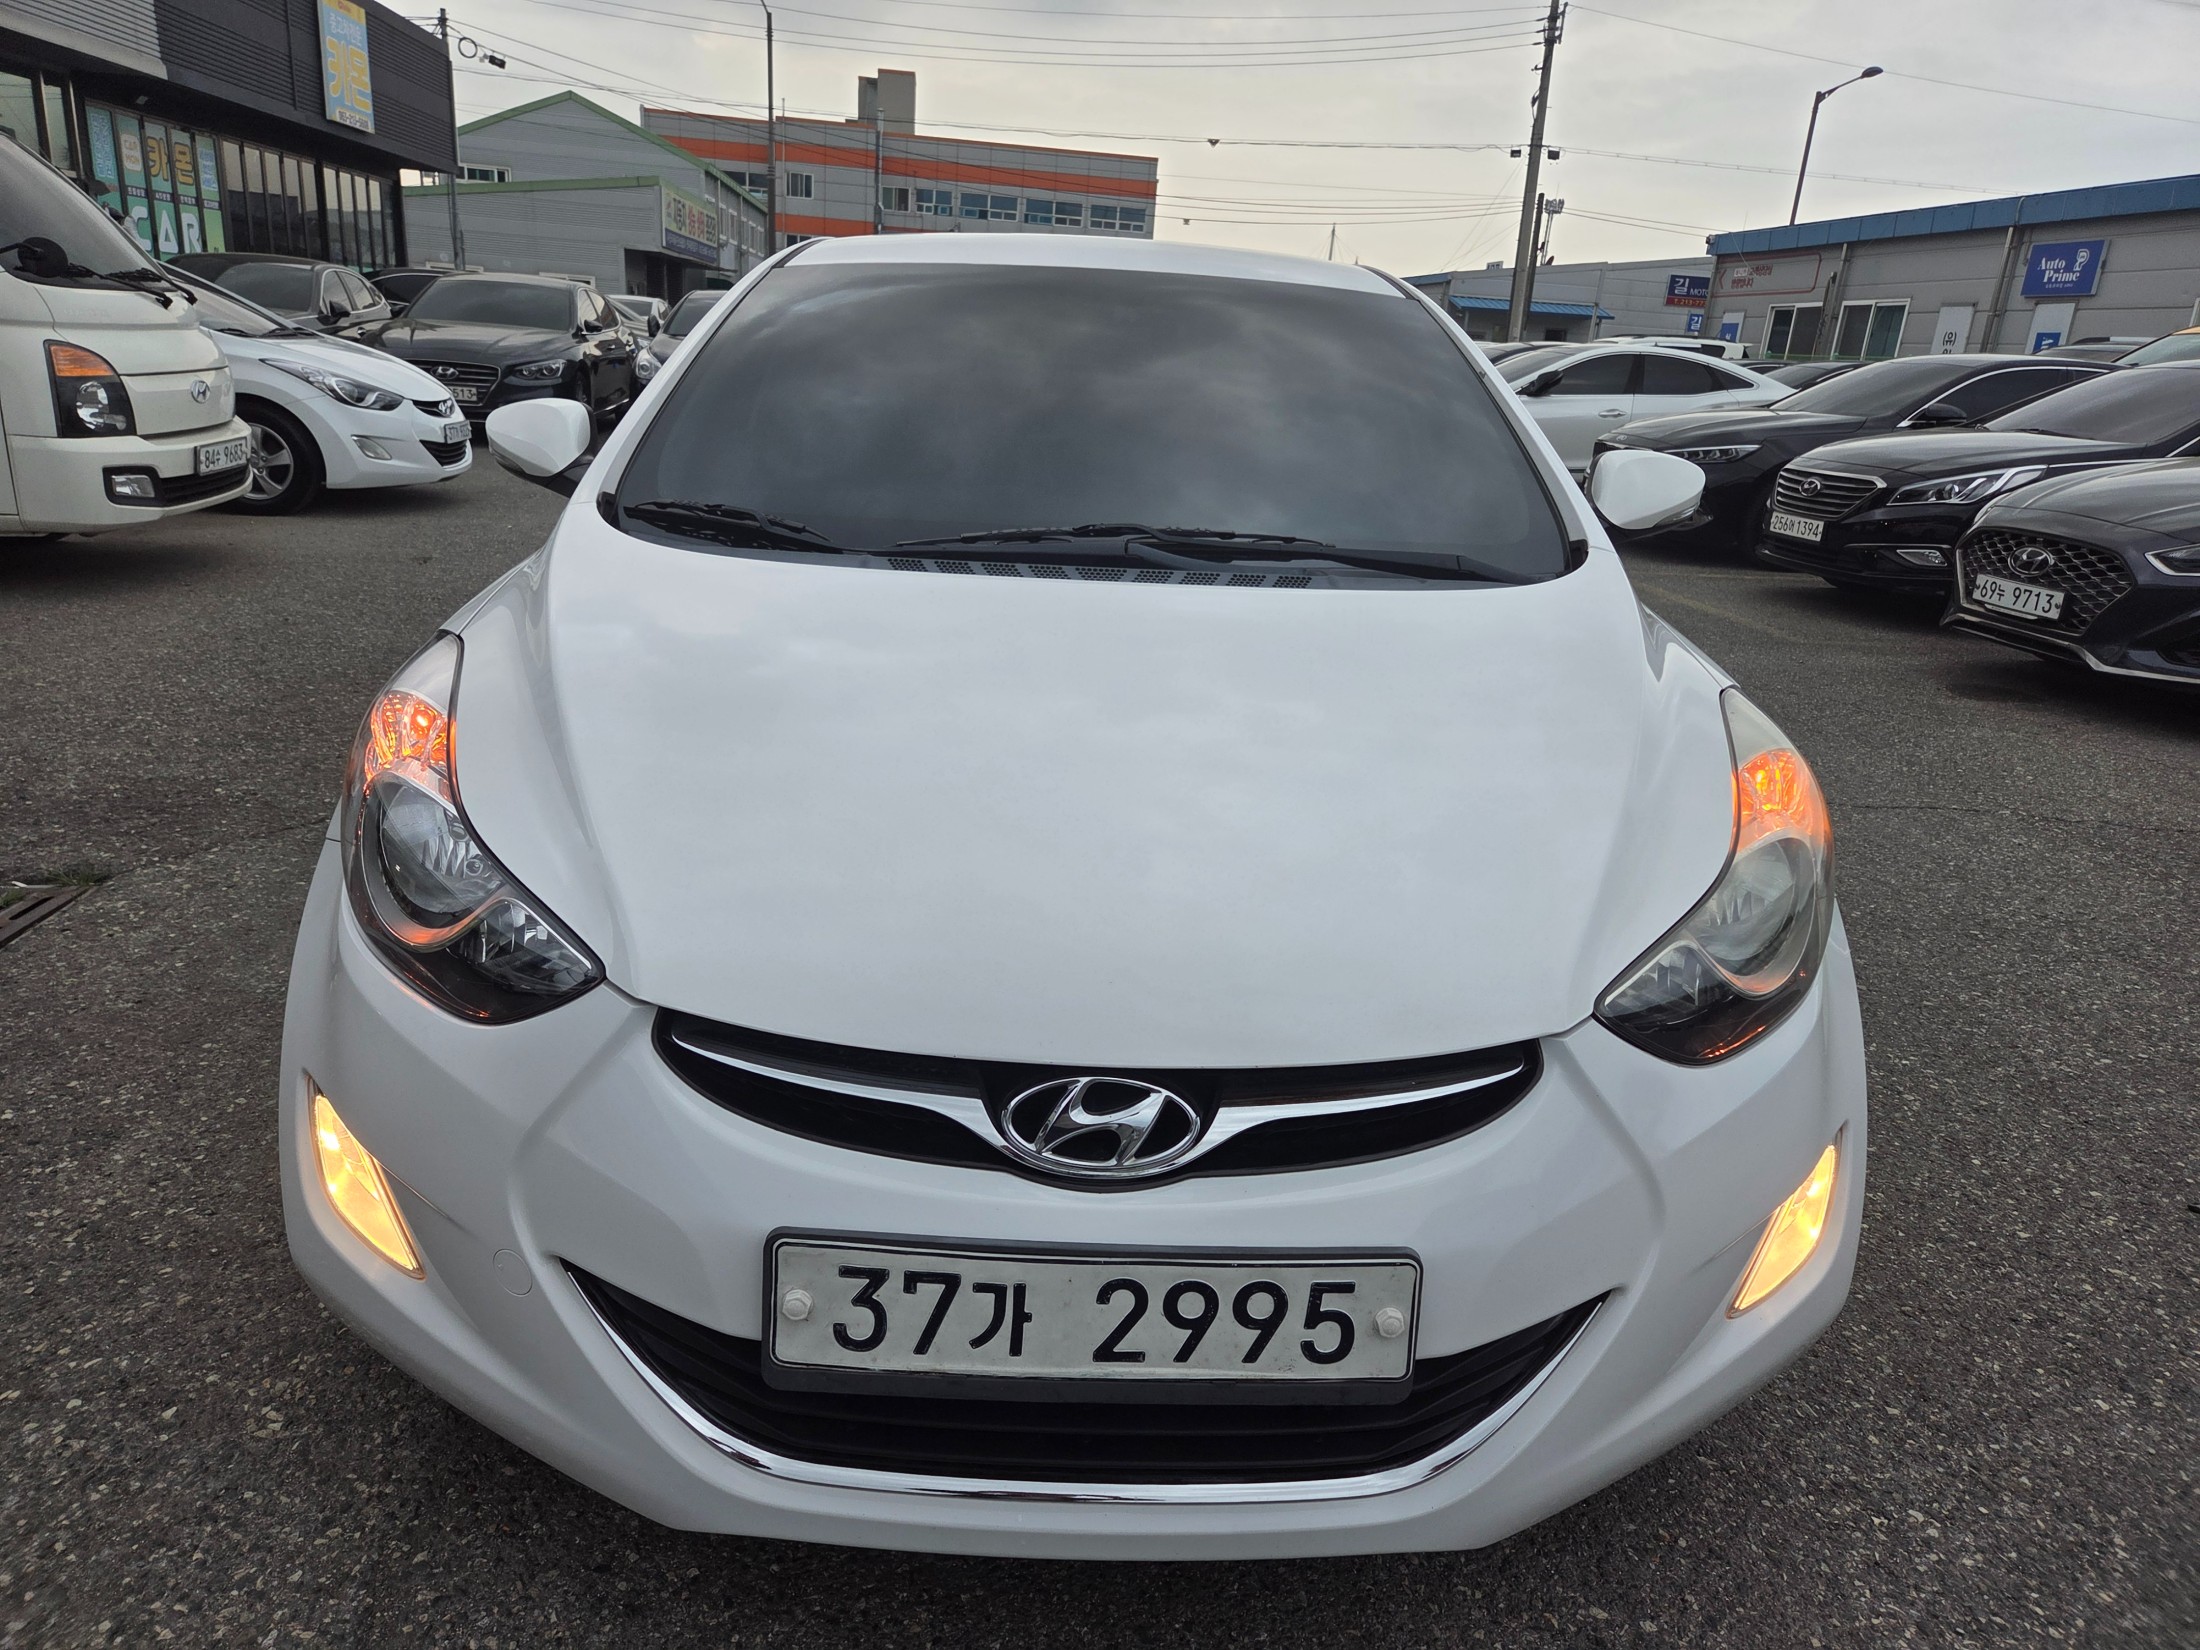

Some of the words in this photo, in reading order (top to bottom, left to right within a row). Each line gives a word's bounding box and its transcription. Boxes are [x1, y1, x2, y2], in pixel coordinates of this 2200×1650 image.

[326, 36, 372, 113] 카몬
[147, 136, 195, 186] 카몬
[2037, 257, 2066, 270] Auto
[1674, 277, 1690, 295] 길
[2043, 269, 2080, 283] Prime
[1690, 316, 1703, 331] 길
[450, 387, 473, 400] 513
[223, 442, 243, 465] 9683
[1980, 579, 2006, 602] 69누
[2012, 586, 2055, 614] 9713
[832, 1264, 1033, 1356] 37가
[1092, 1278, 1356, 1365] 2995
